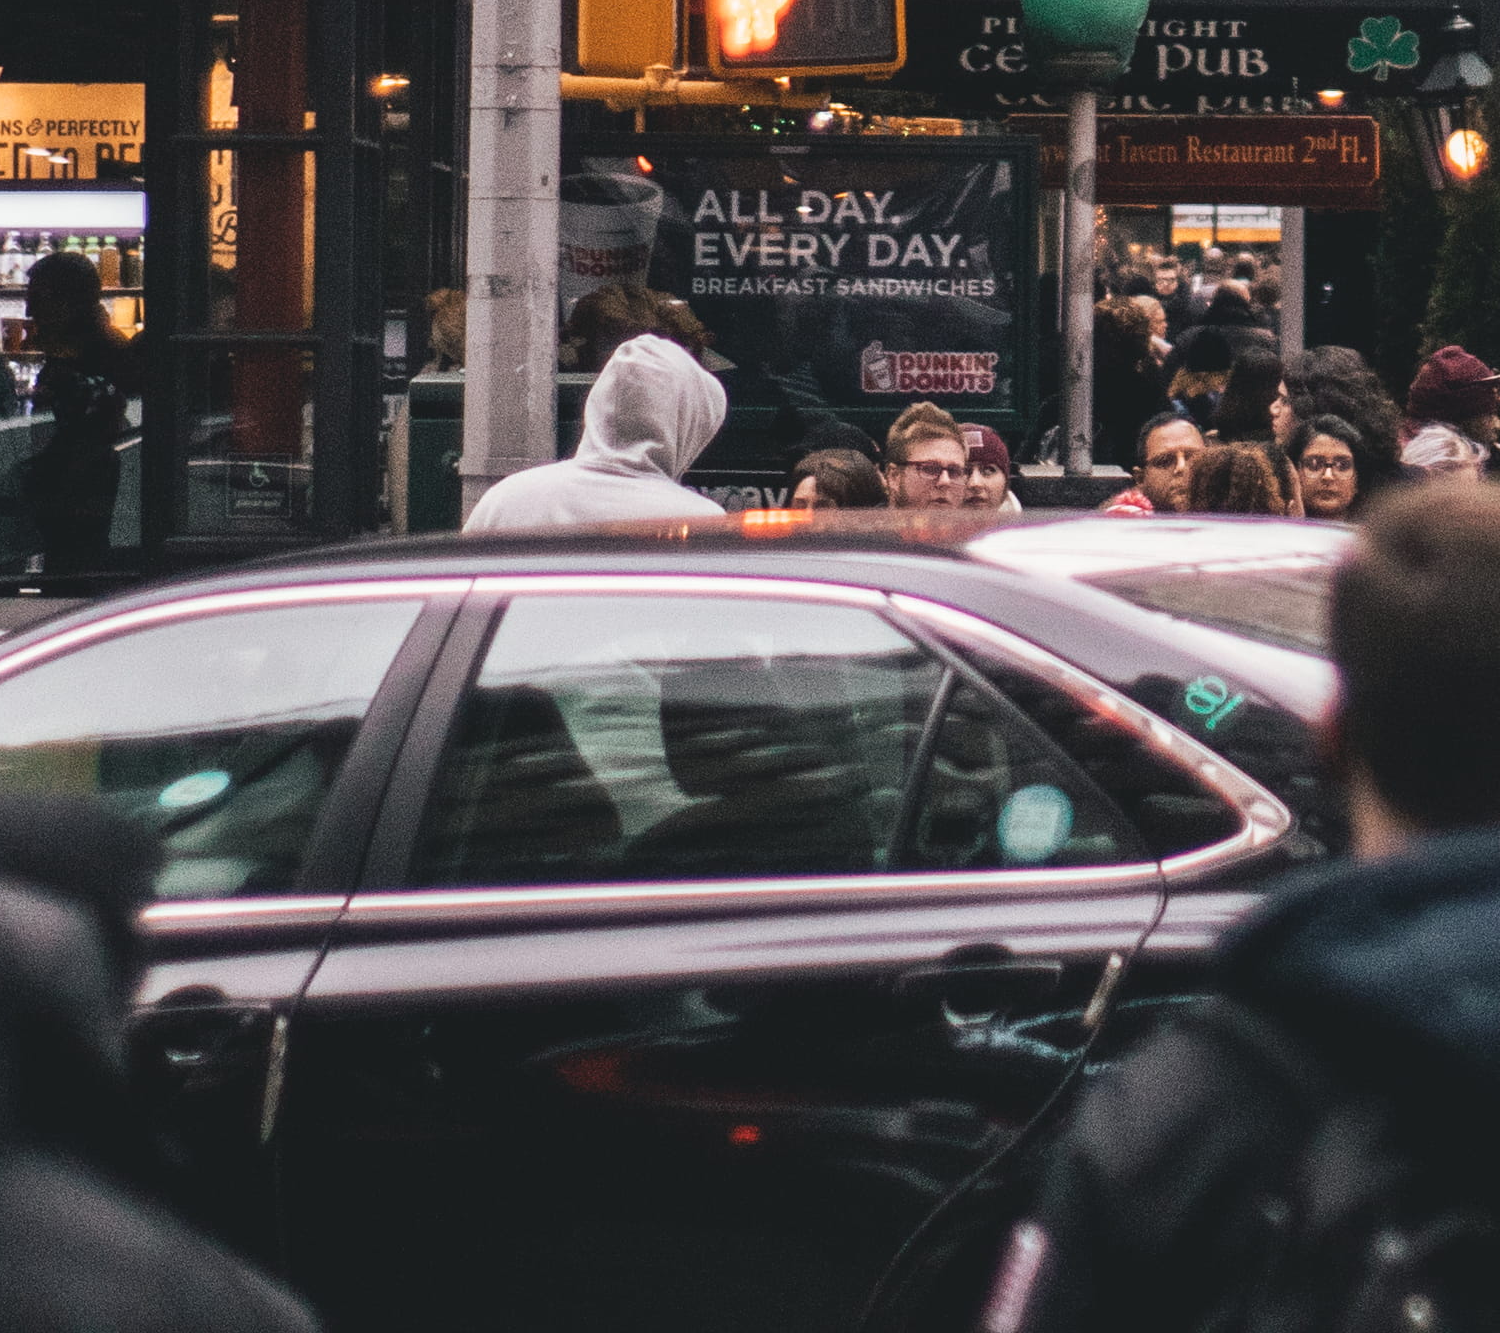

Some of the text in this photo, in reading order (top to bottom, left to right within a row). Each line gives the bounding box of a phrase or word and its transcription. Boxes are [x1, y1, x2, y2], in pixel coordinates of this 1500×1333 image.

[46, 119, 141, 136] PERFECTLY
[1186, 135, 1295, 164] Restaurant
[694, 189, 901, 225] ALL DAY.
[694, 233, 967, 269] EVERY DAY.
[691, 276, 996, 298] BREAKFAST SANDWICHES
[897, 372, 997, 392] DONUTS
